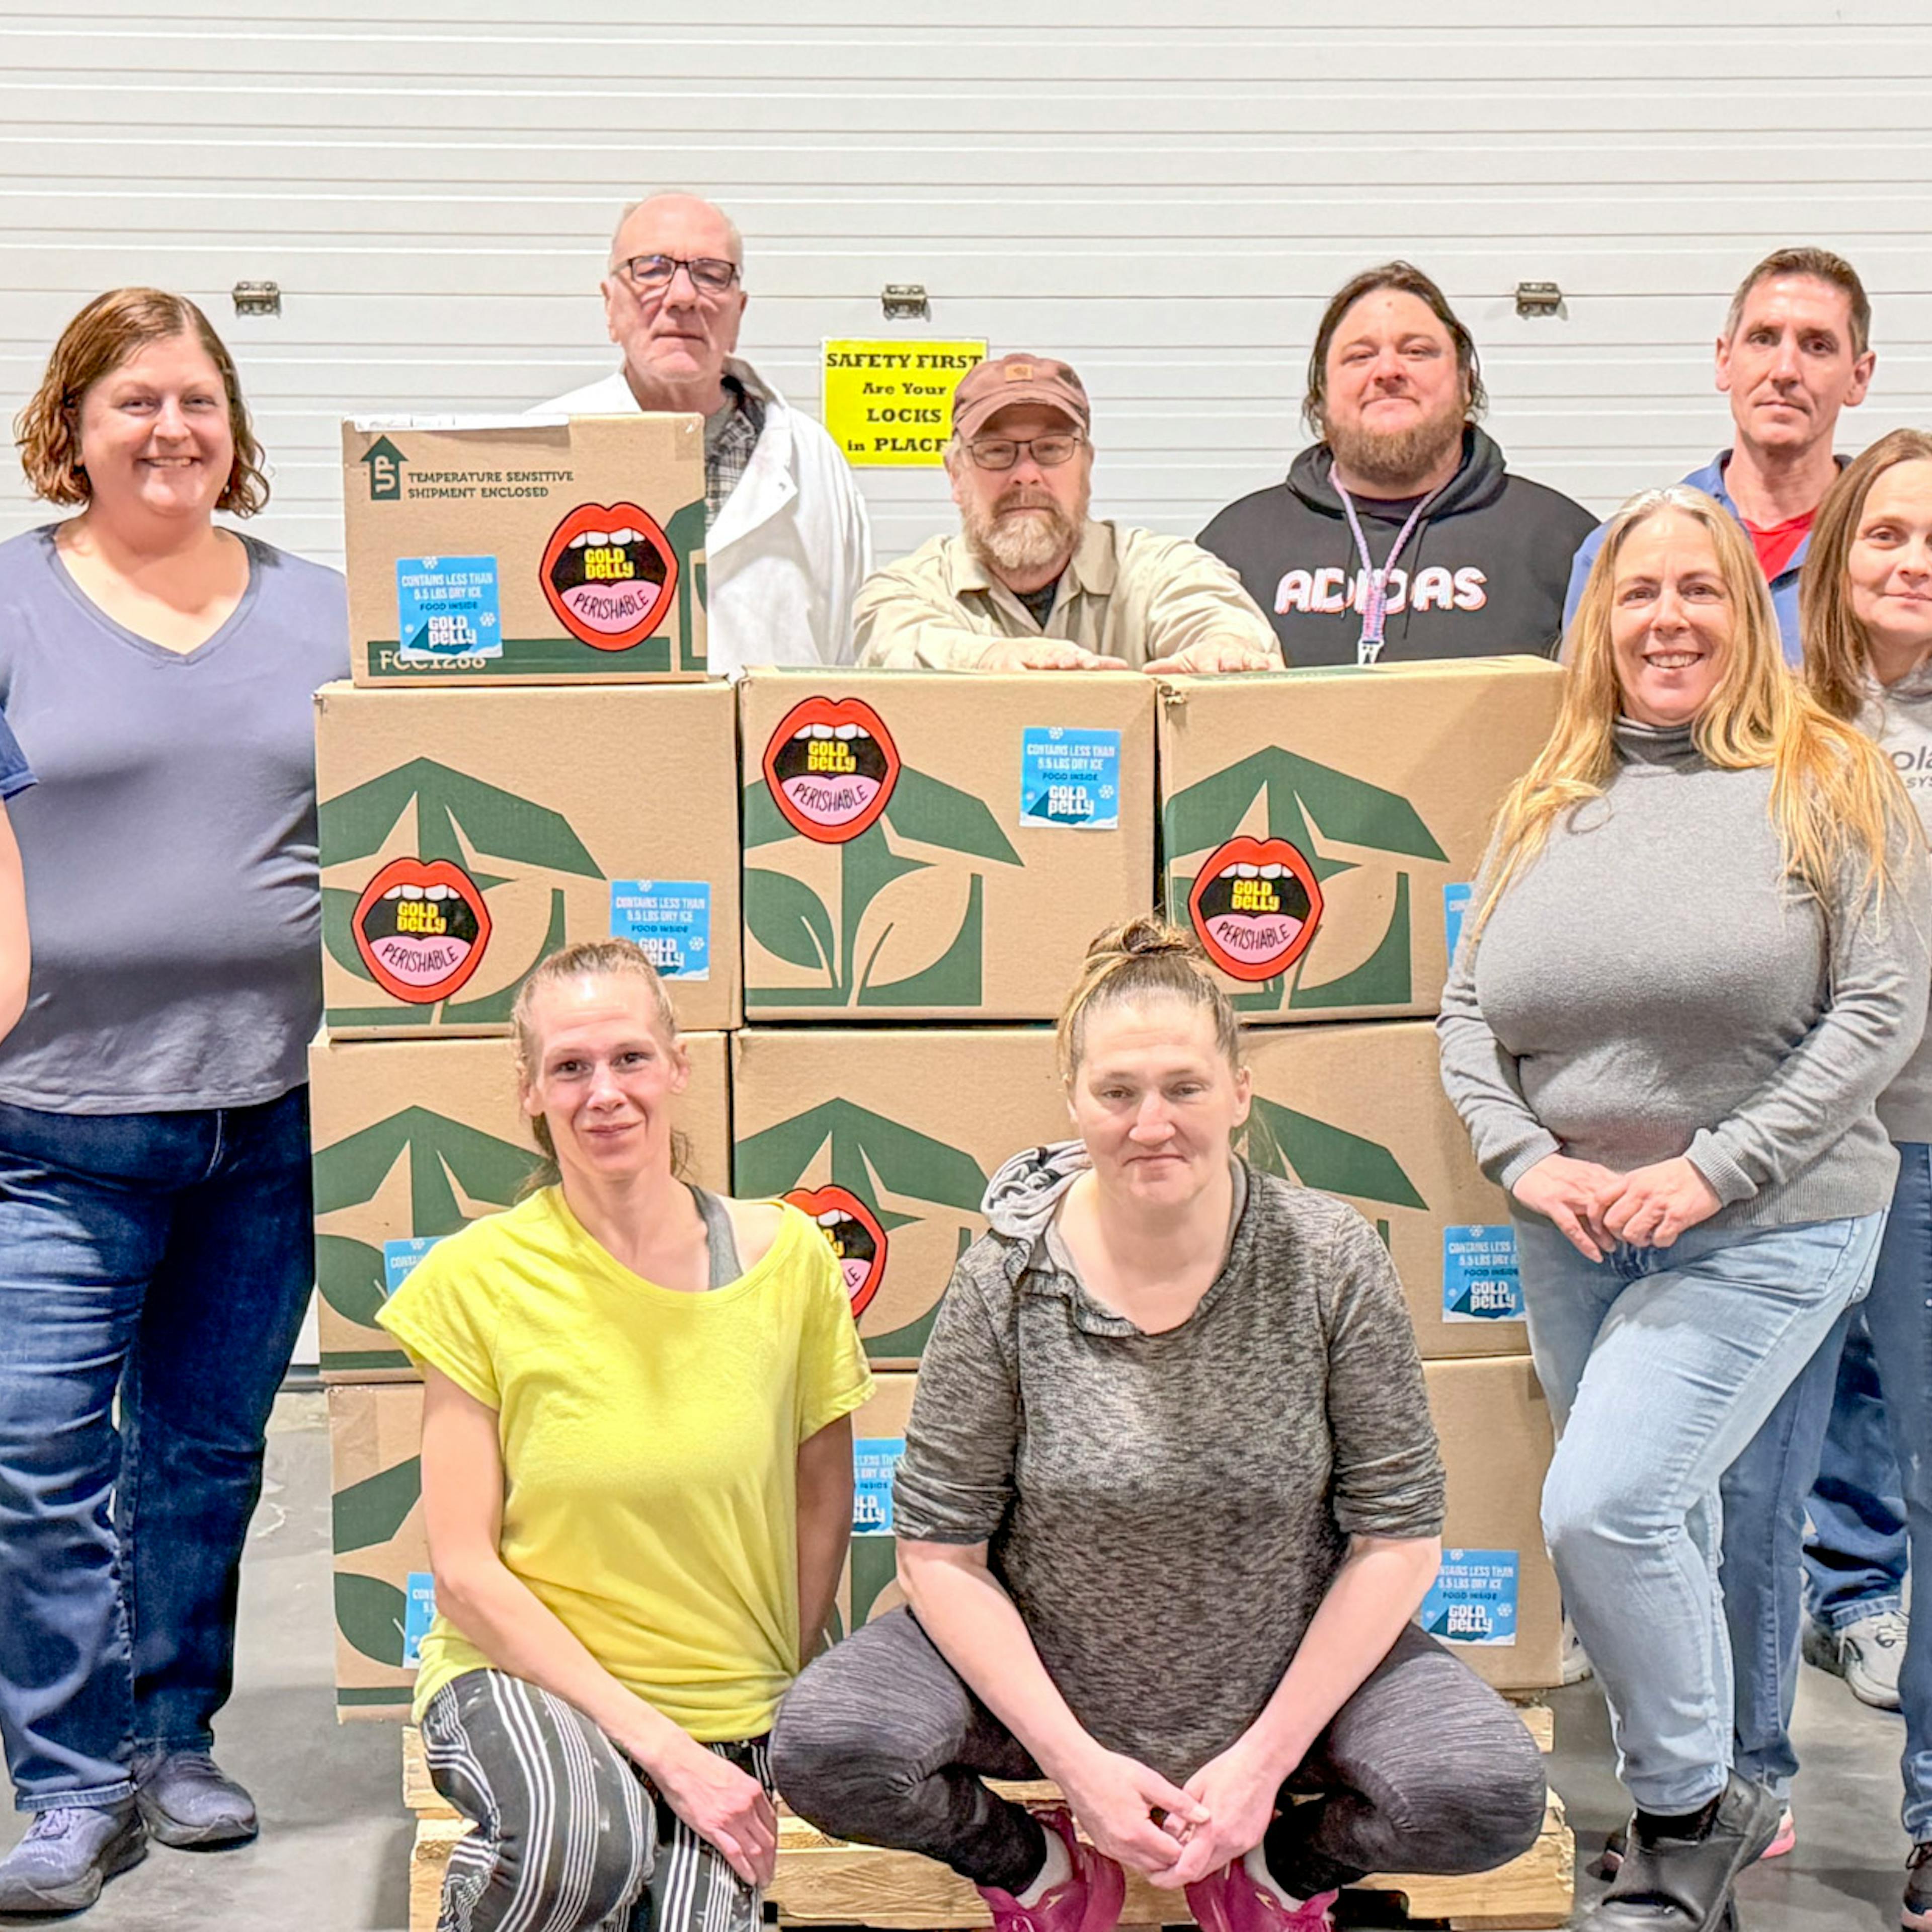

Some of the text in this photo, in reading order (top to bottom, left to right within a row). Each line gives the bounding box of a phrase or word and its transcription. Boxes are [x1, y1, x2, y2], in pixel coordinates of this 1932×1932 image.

[827, 353, 983, 368] SAFETY FIRST
[862, 382, 947, 395] Are Your
[866, 409, 941, 422] LOCKS
[848, 440, 865, 451] in
[375, 455, 395, 493] UP
[408, 471, 573, 483] TEMPERATURE SENSITIVE
[408, 487, 548, 499] SHIPMENT ENCLOSED
[584, 547, 625, 564] GOLD
[402, 573, 493, 587] CONTAINS LESS THAN
[431, 588, 447, 600] LBS
[448, 587, 466, 599] DRY
[468, 586, 482, 598] ICE
[420, 601, 477, 611] FOOD INSIDE
[573, 590, 649, 619] PERISHABLE
[428, 615, 467, 629] GOLD
[808, 741, 849, 757] GOLD
[1027, 744, 1115, 757] CONTAINS LESS THAN
[1054, 758, 1069, 769] LBS
[1072, 758, 1088, 770] DRY
[1090, 759, 1103, 771] ICE
[793, 782, 868, 812] PERISHABLE
[1049, 785, 1087, 800] GOLD
[1233, 879, 1272, 896] GOLD
[398, 902, 439, 918] GOLD
[616, 897, 705, 910] CONTAINS LESS THAN
[643, 911, 659, 922] LBS
[661, 911, 678, 922] DRY
[679, 911, 694, 923] ICE
[1217, 921, 1290, 950] PERISHABLE
[638, 937, 677, 952] GOLD
[382, 943, 458, 972] PERISHABLE
[1448, 1242, 1489, 1254] CONTAINS
[1491, 1241, 1510, 1252] LESS
[1475, 1255, 1490, 1265] LBS
[1471, 1281, 1508, 1295] GOLD
[1470, 1566, 1490, 1577] LESS
[1492, 1566, 1513, 1577] THAN
[1454, 1578, 1469, 1589] LBS
[1471, 1579, 1487, 1589] DRY
[1448, 1604, 1485, 1618] GOLD
